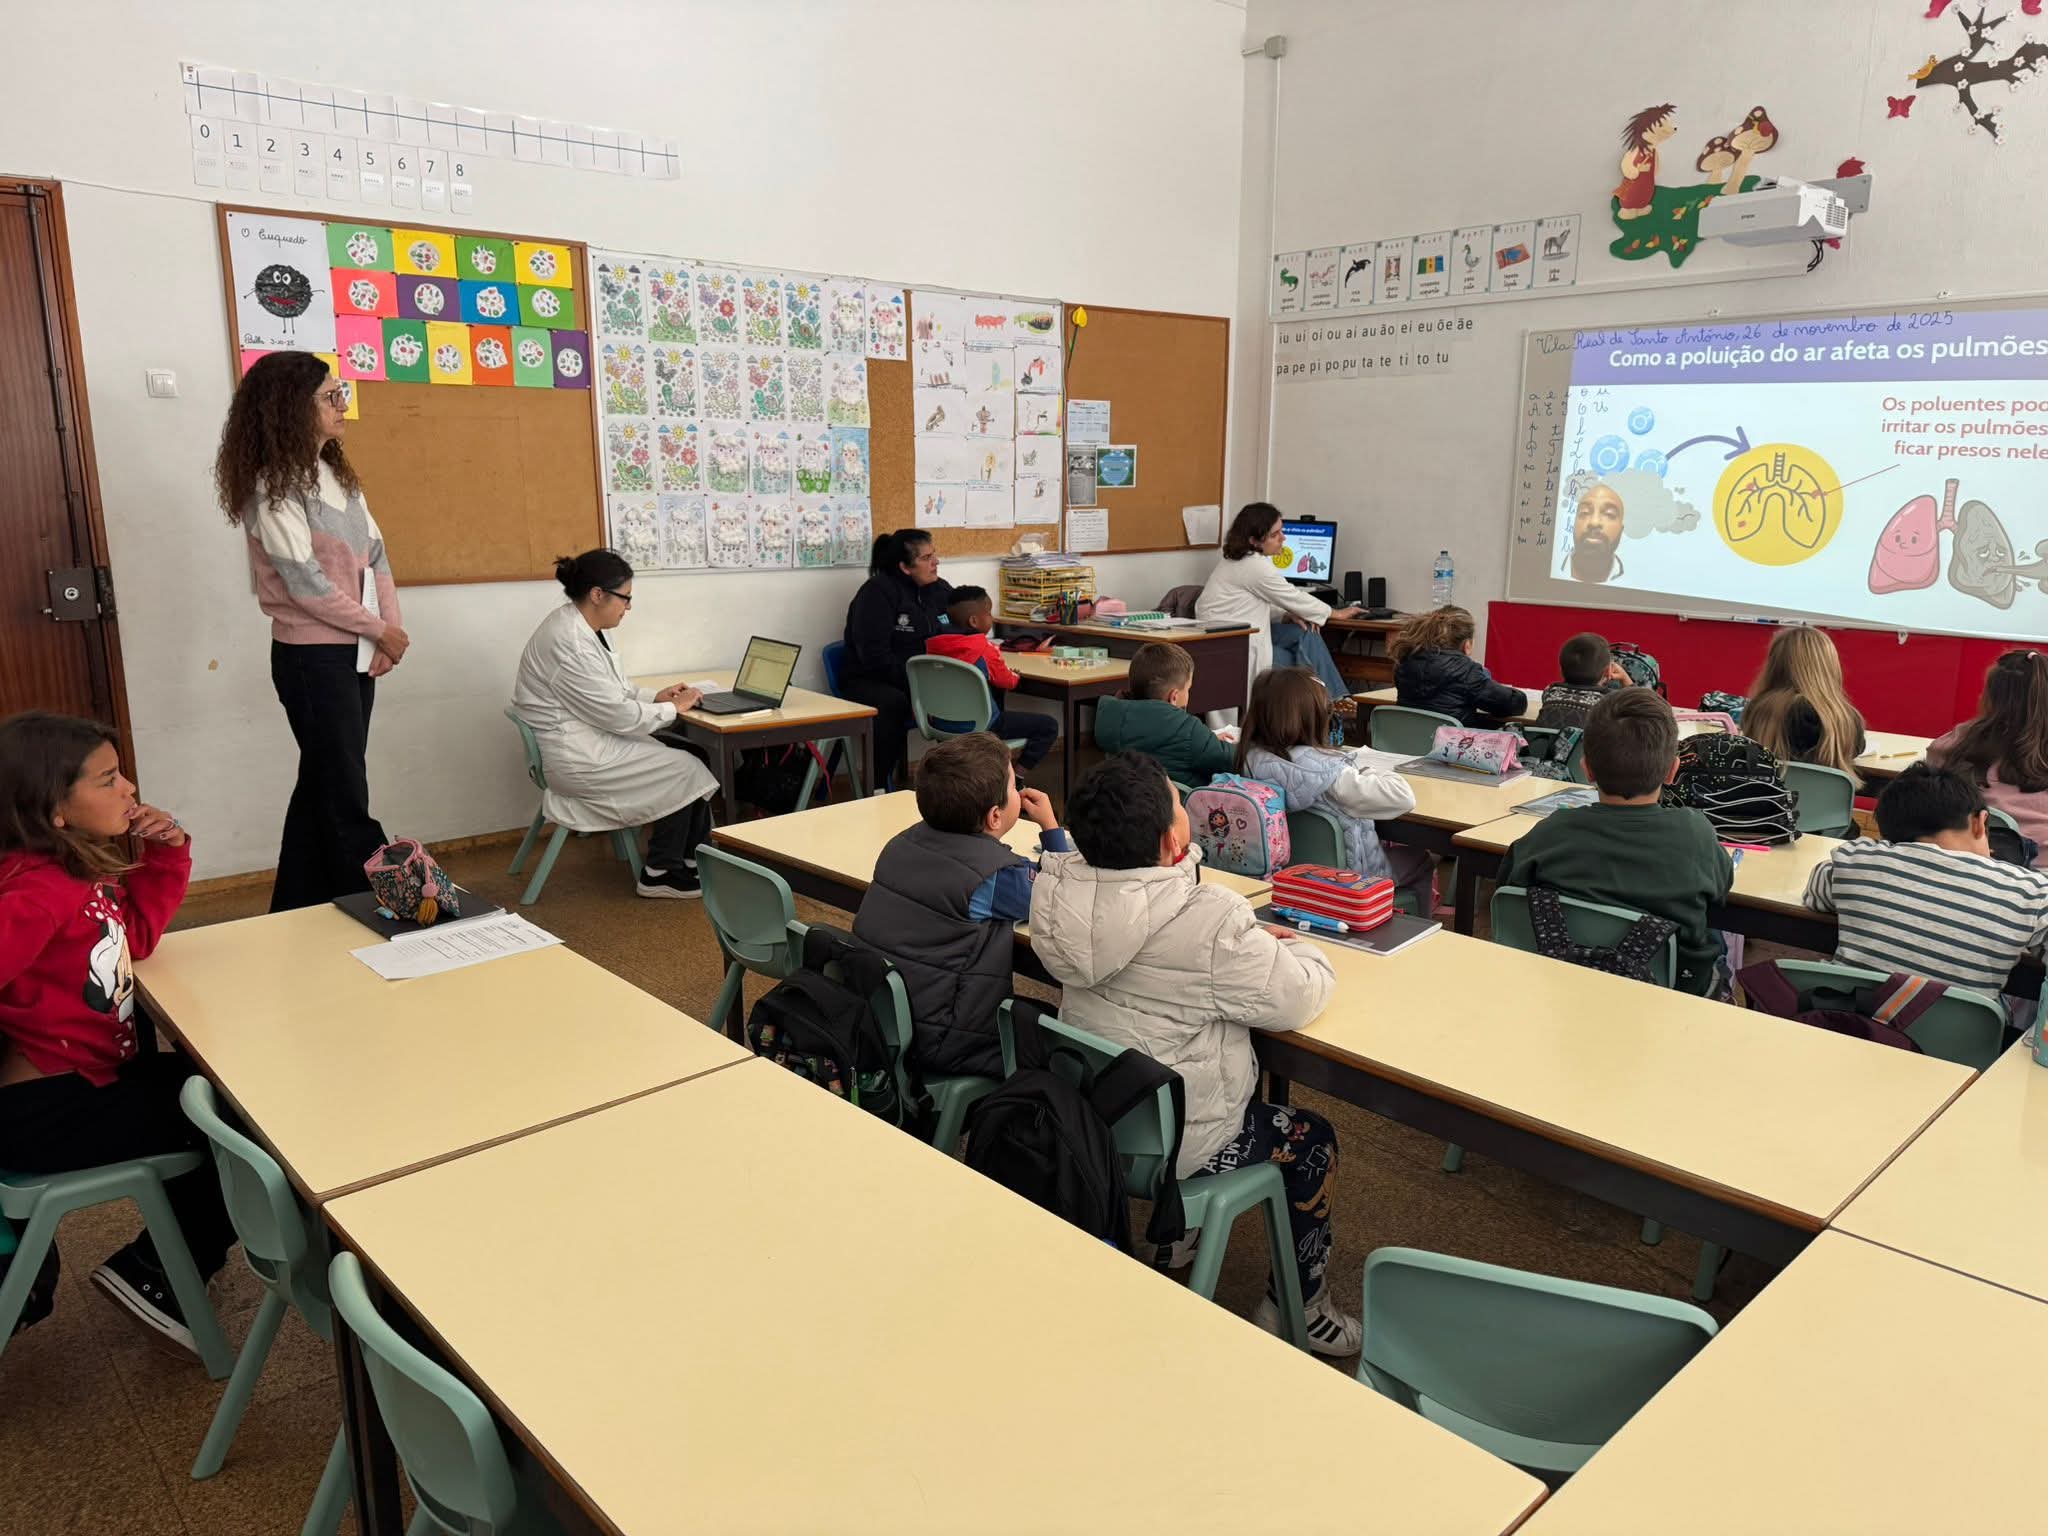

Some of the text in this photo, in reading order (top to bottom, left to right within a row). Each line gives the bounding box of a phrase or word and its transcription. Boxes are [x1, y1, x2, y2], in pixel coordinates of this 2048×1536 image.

[200, 124, 464, 176] 0 1 2 3 4 5 6 7 8
[1279, 317, 1473, 344] iu ui oi ou ai au ão ei eu õe ãe
[1571, 329, 1606, 349] Real
[1610, 331, 1623, 345] de
[1629, 328, 1669, 346] Santo
[1743, 325, 1762, 339] 26
[1772, 320, 1789, 338] de
[1794, 315, 1879, 336] novembro
[1886, 311, 1901, 331] de
[1907, 310, 1954, 329] 2025
[1277, 352, 1449, 376] pa pe pi po pu ta te ti to tu
[1609, 335, 2048, 370] Como a poluição do ar afeta os pulmões
[1882, 397, 1906, 411] Os
[1911, 395, 2006, 415] poluentes
[1881, 418, 2048, 438] irritar os pulmões
[1894, 440, 1934, 455] ficar
[1938, 445, 2001, 460] presos
